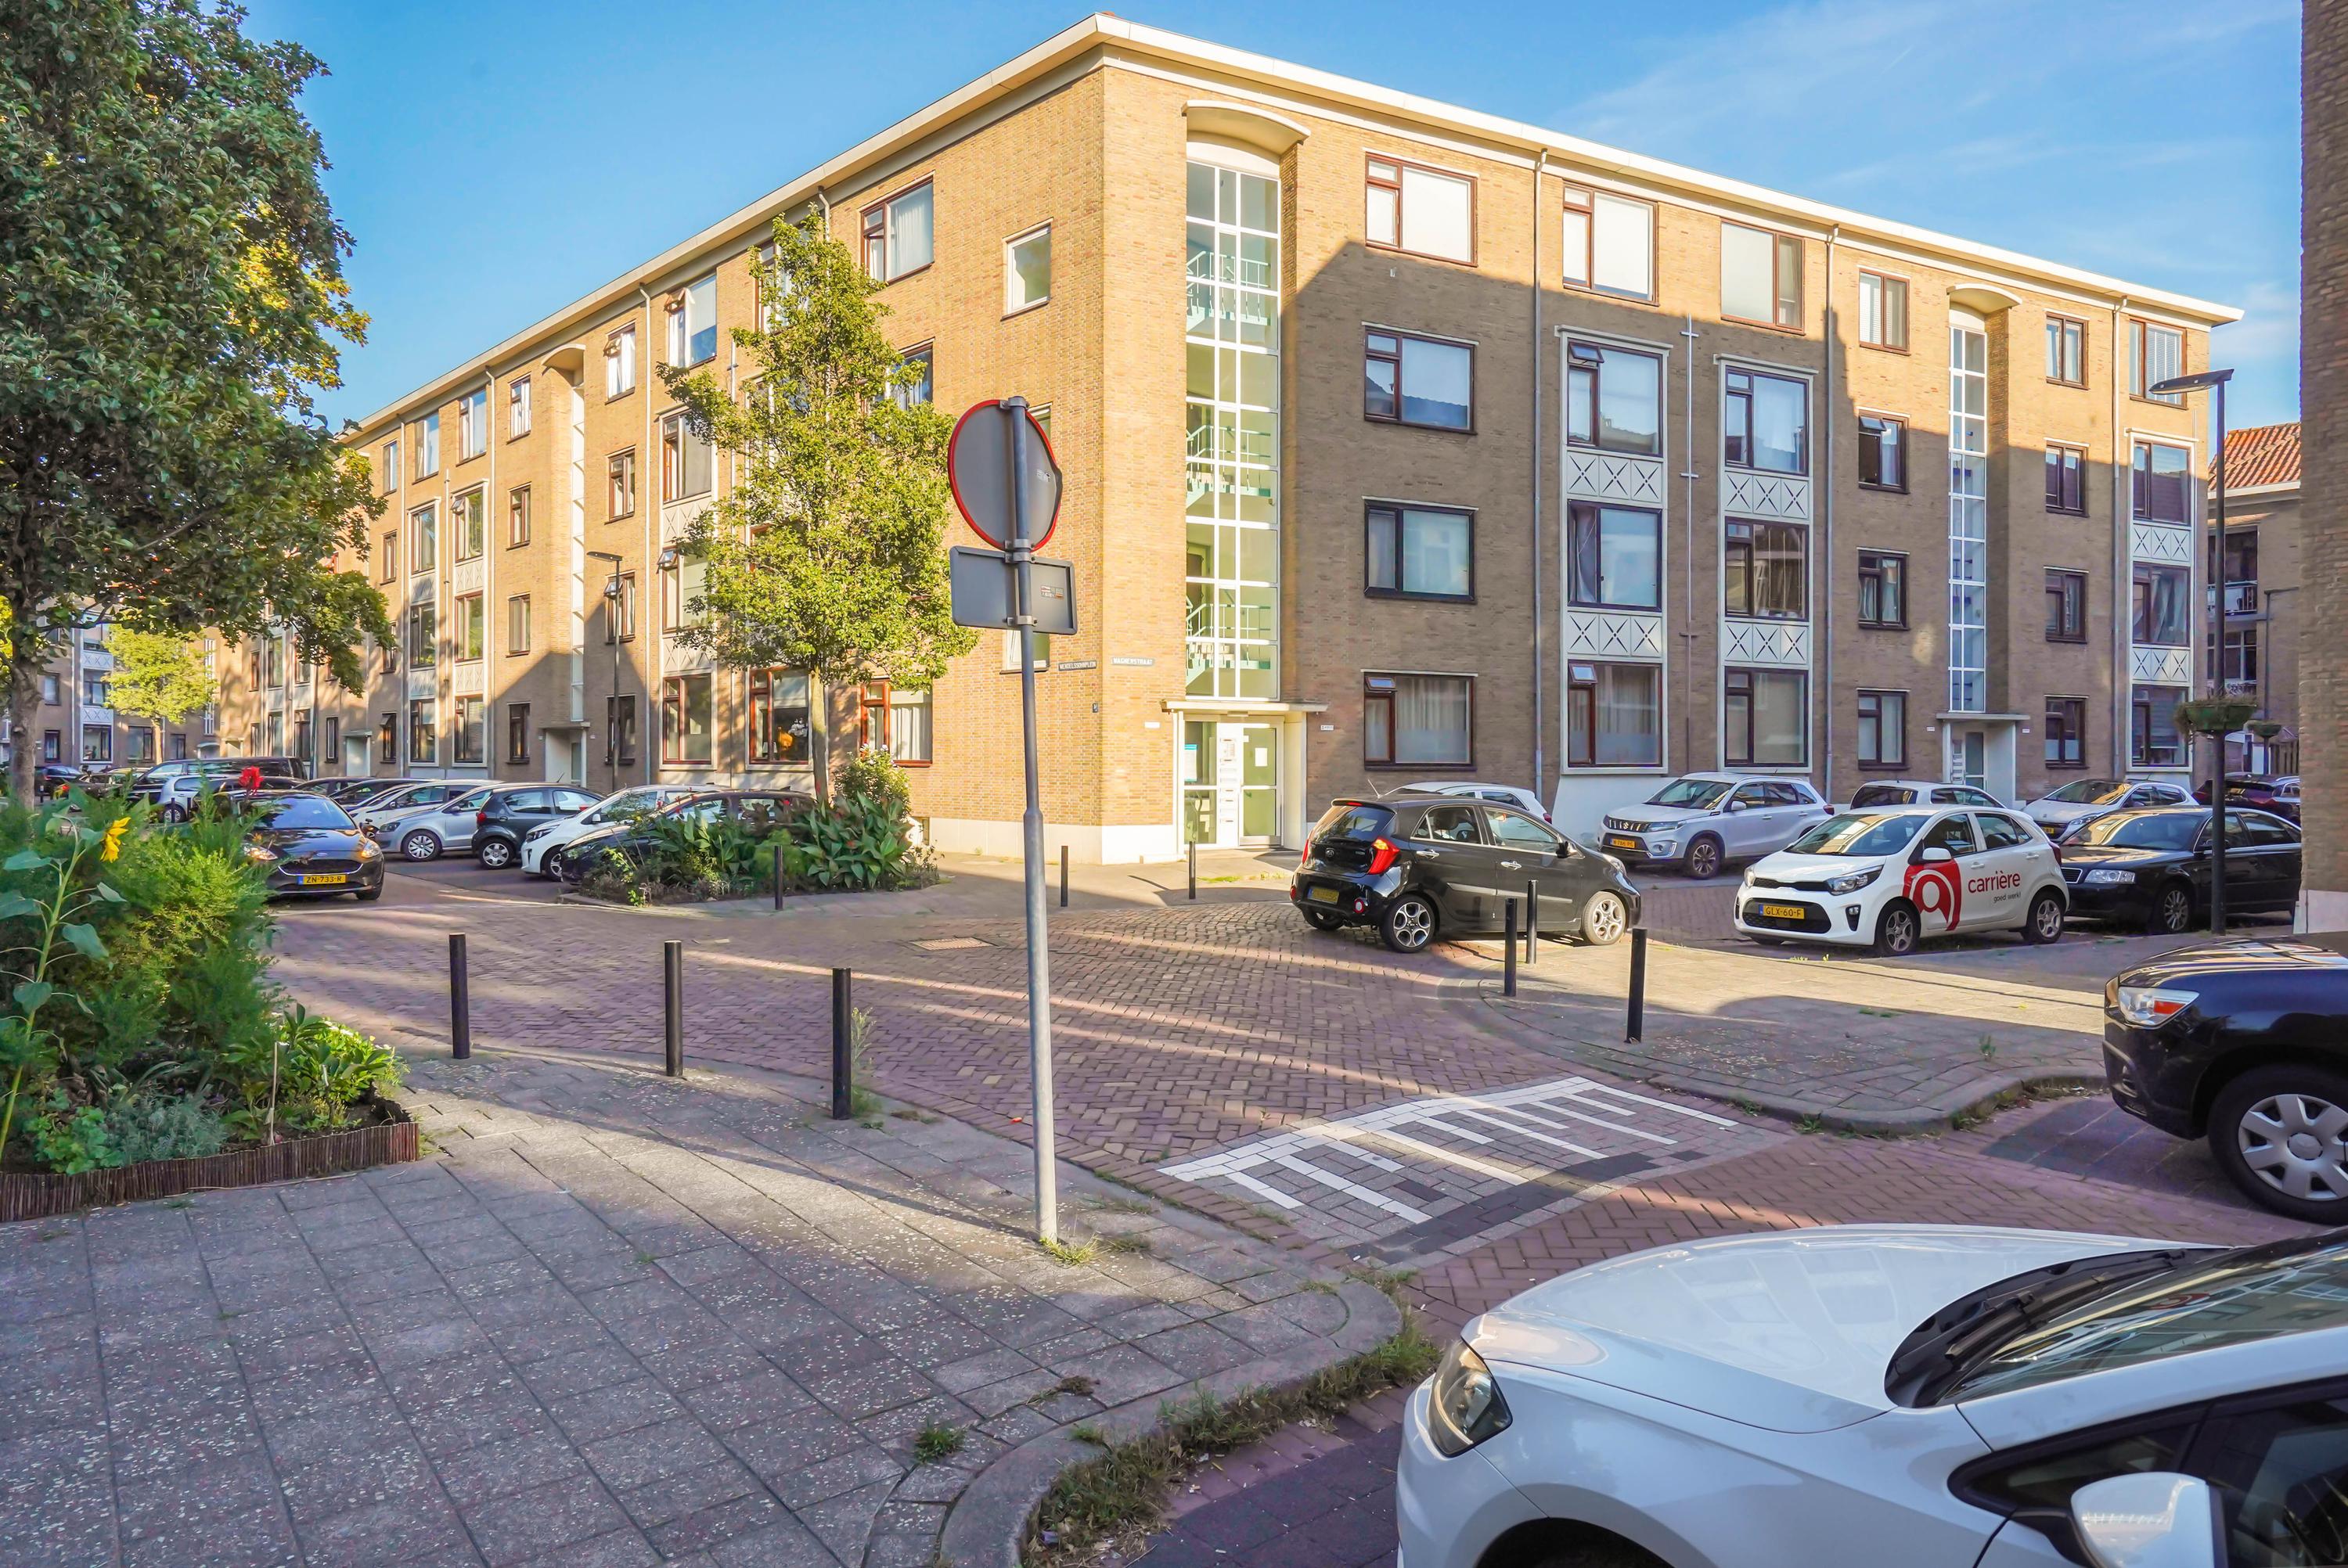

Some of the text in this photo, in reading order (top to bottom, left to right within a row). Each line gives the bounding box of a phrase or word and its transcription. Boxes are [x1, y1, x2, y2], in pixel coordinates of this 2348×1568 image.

[1968, 870, 2021, 893] carrière
[1993, 894, 2007, 904] goed
[1766, 907, 1802, 918] GLX-60-F
